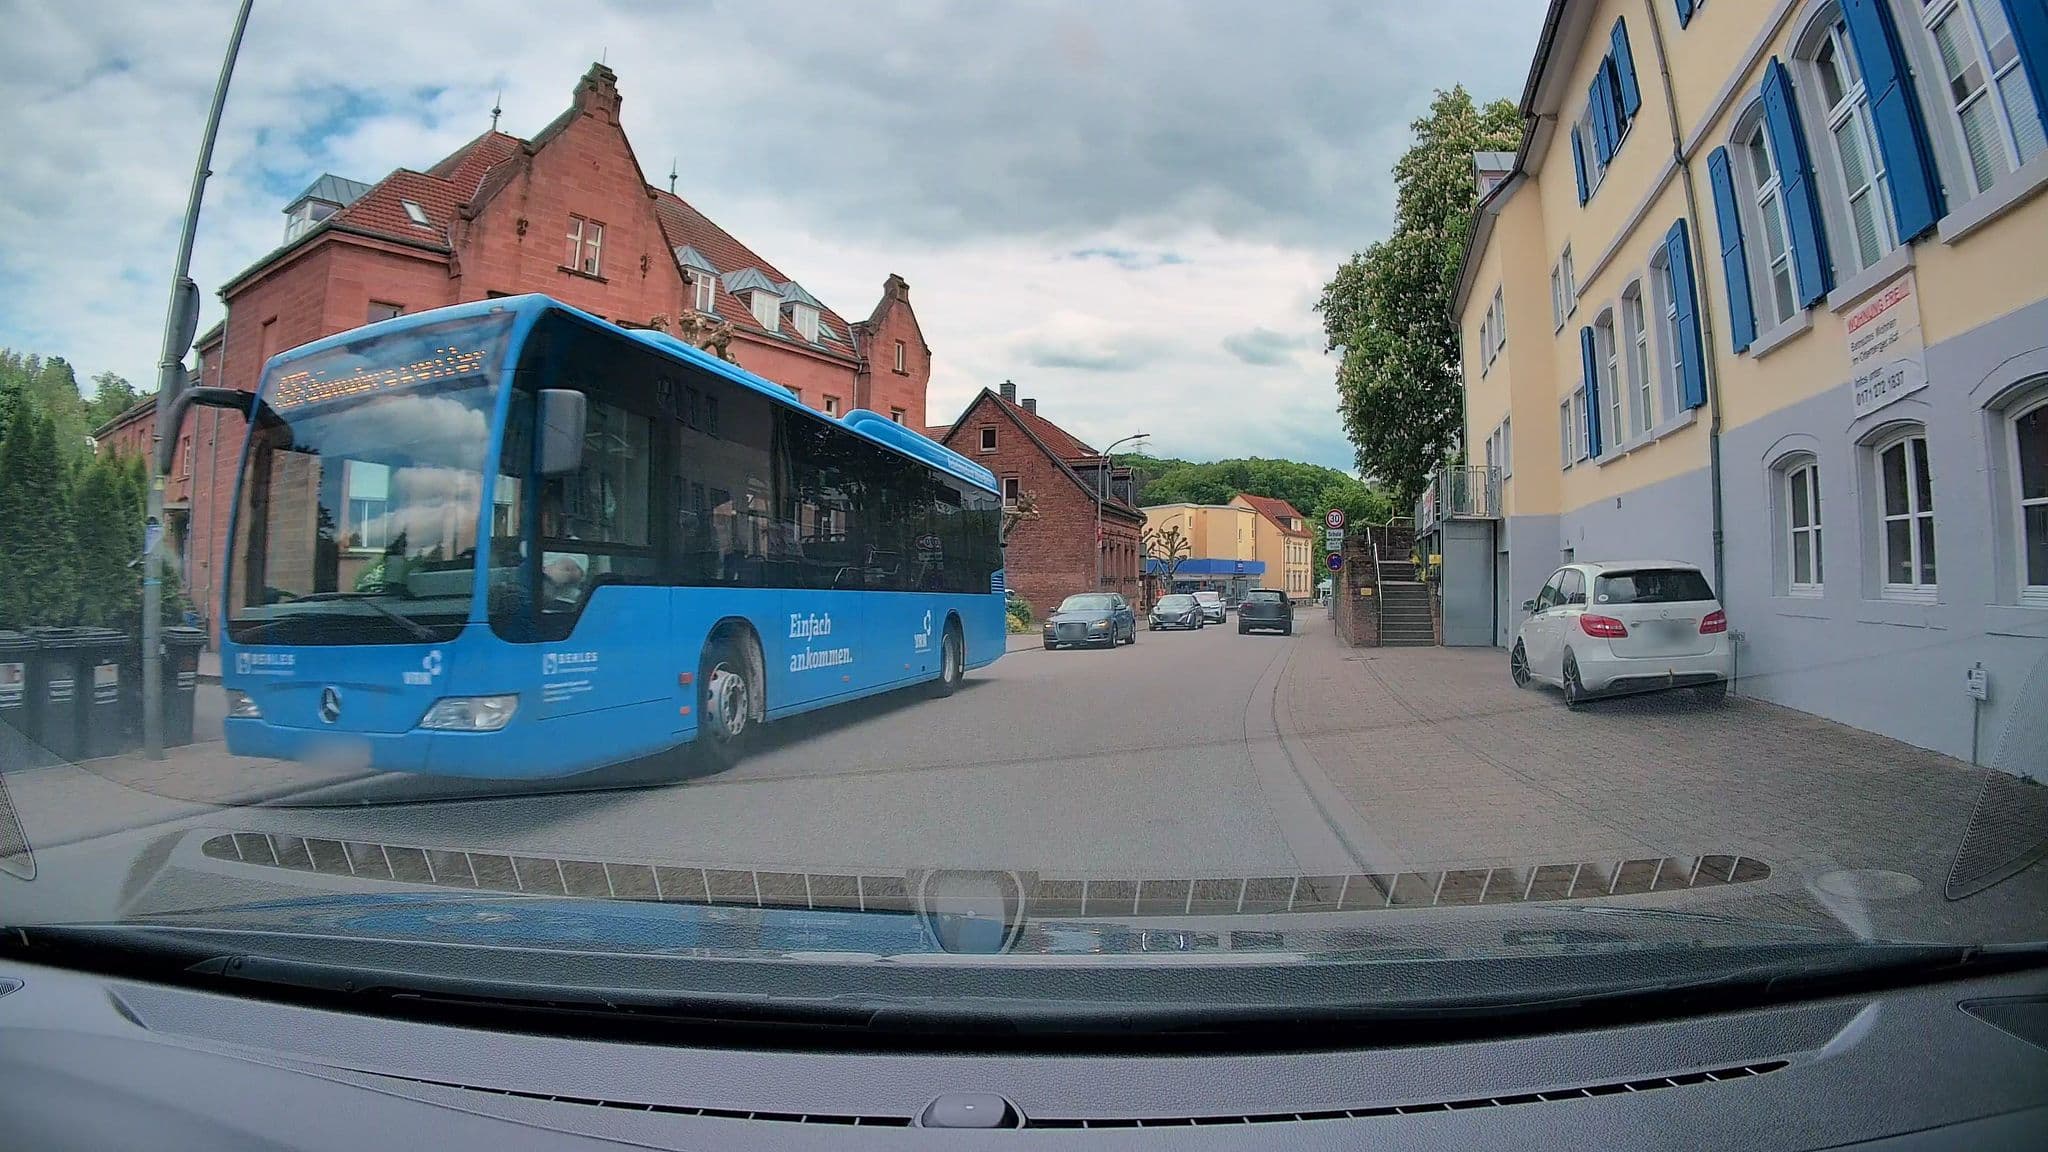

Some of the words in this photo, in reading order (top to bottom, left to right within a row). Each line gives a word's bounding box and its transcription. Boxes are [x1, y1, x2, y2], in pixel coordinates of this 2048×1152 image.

[1329, 514, 1340, 523] 30
[789, 612, 832, 642] Einfach
[789, 646, 853, 673] ankommen.
